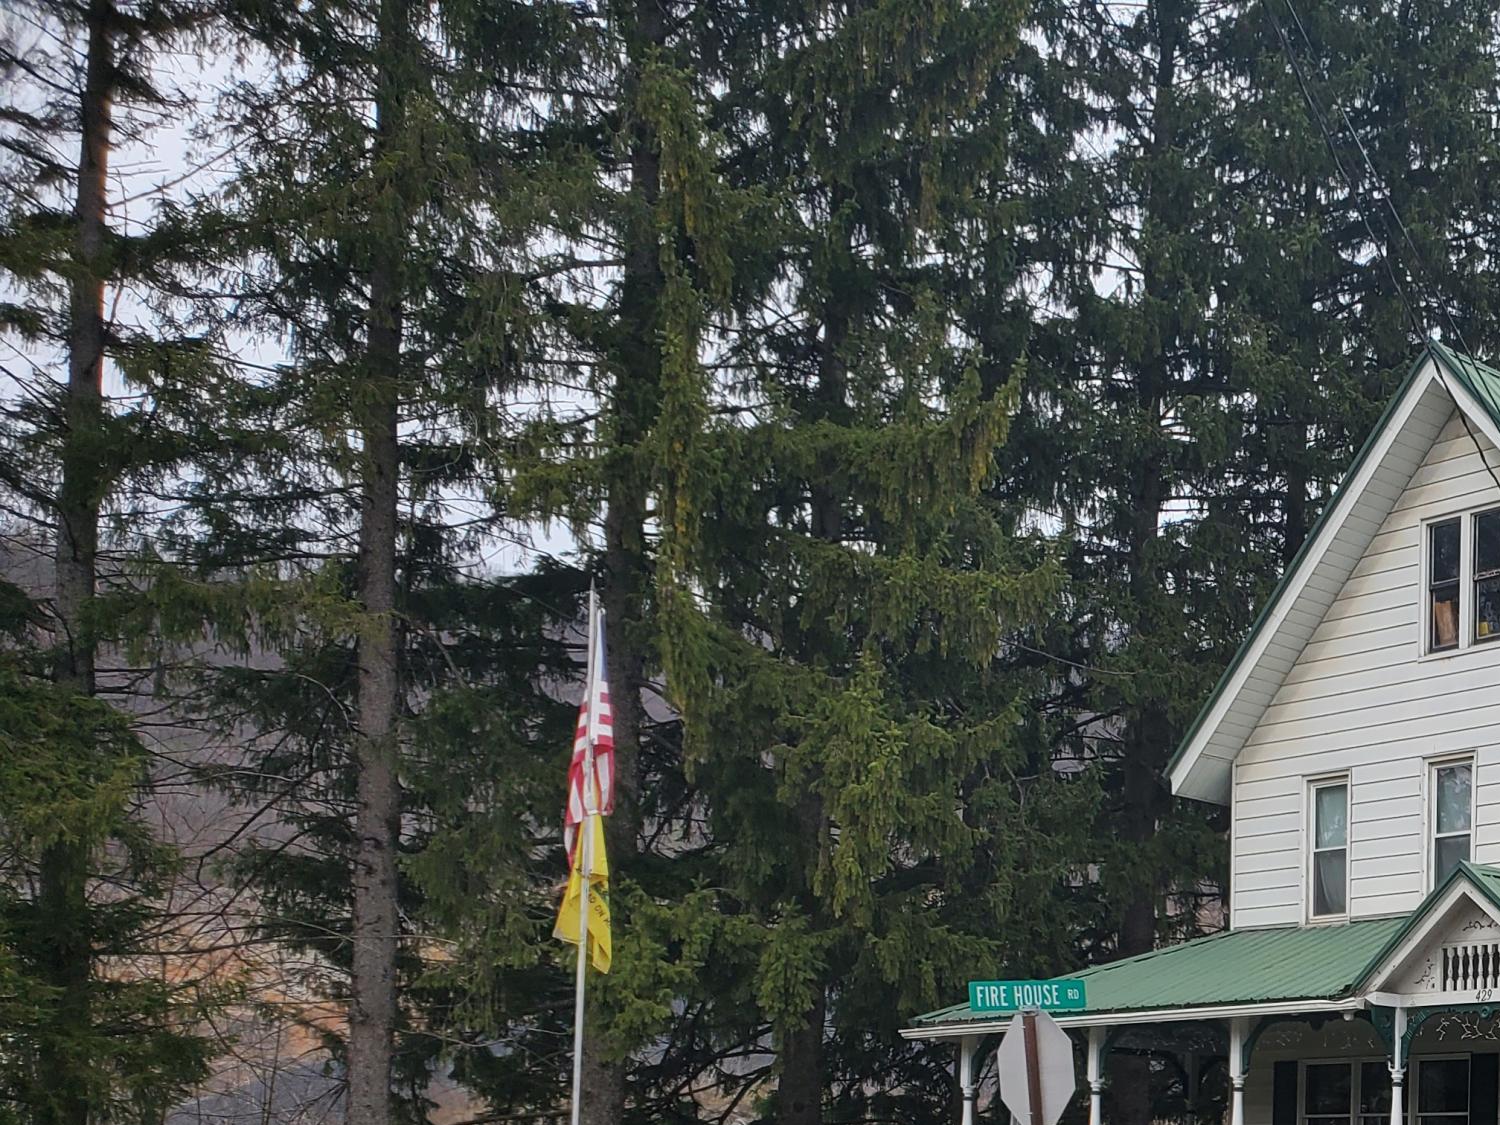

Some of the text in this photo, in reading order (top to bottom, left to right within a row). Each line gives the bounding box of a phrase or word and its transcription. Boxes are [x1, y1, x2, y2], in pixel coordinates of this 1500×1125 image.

[976, 984, 1080, 1007] FIRE HOUSE RD
[1475, 989, 1493, 1002] 429
